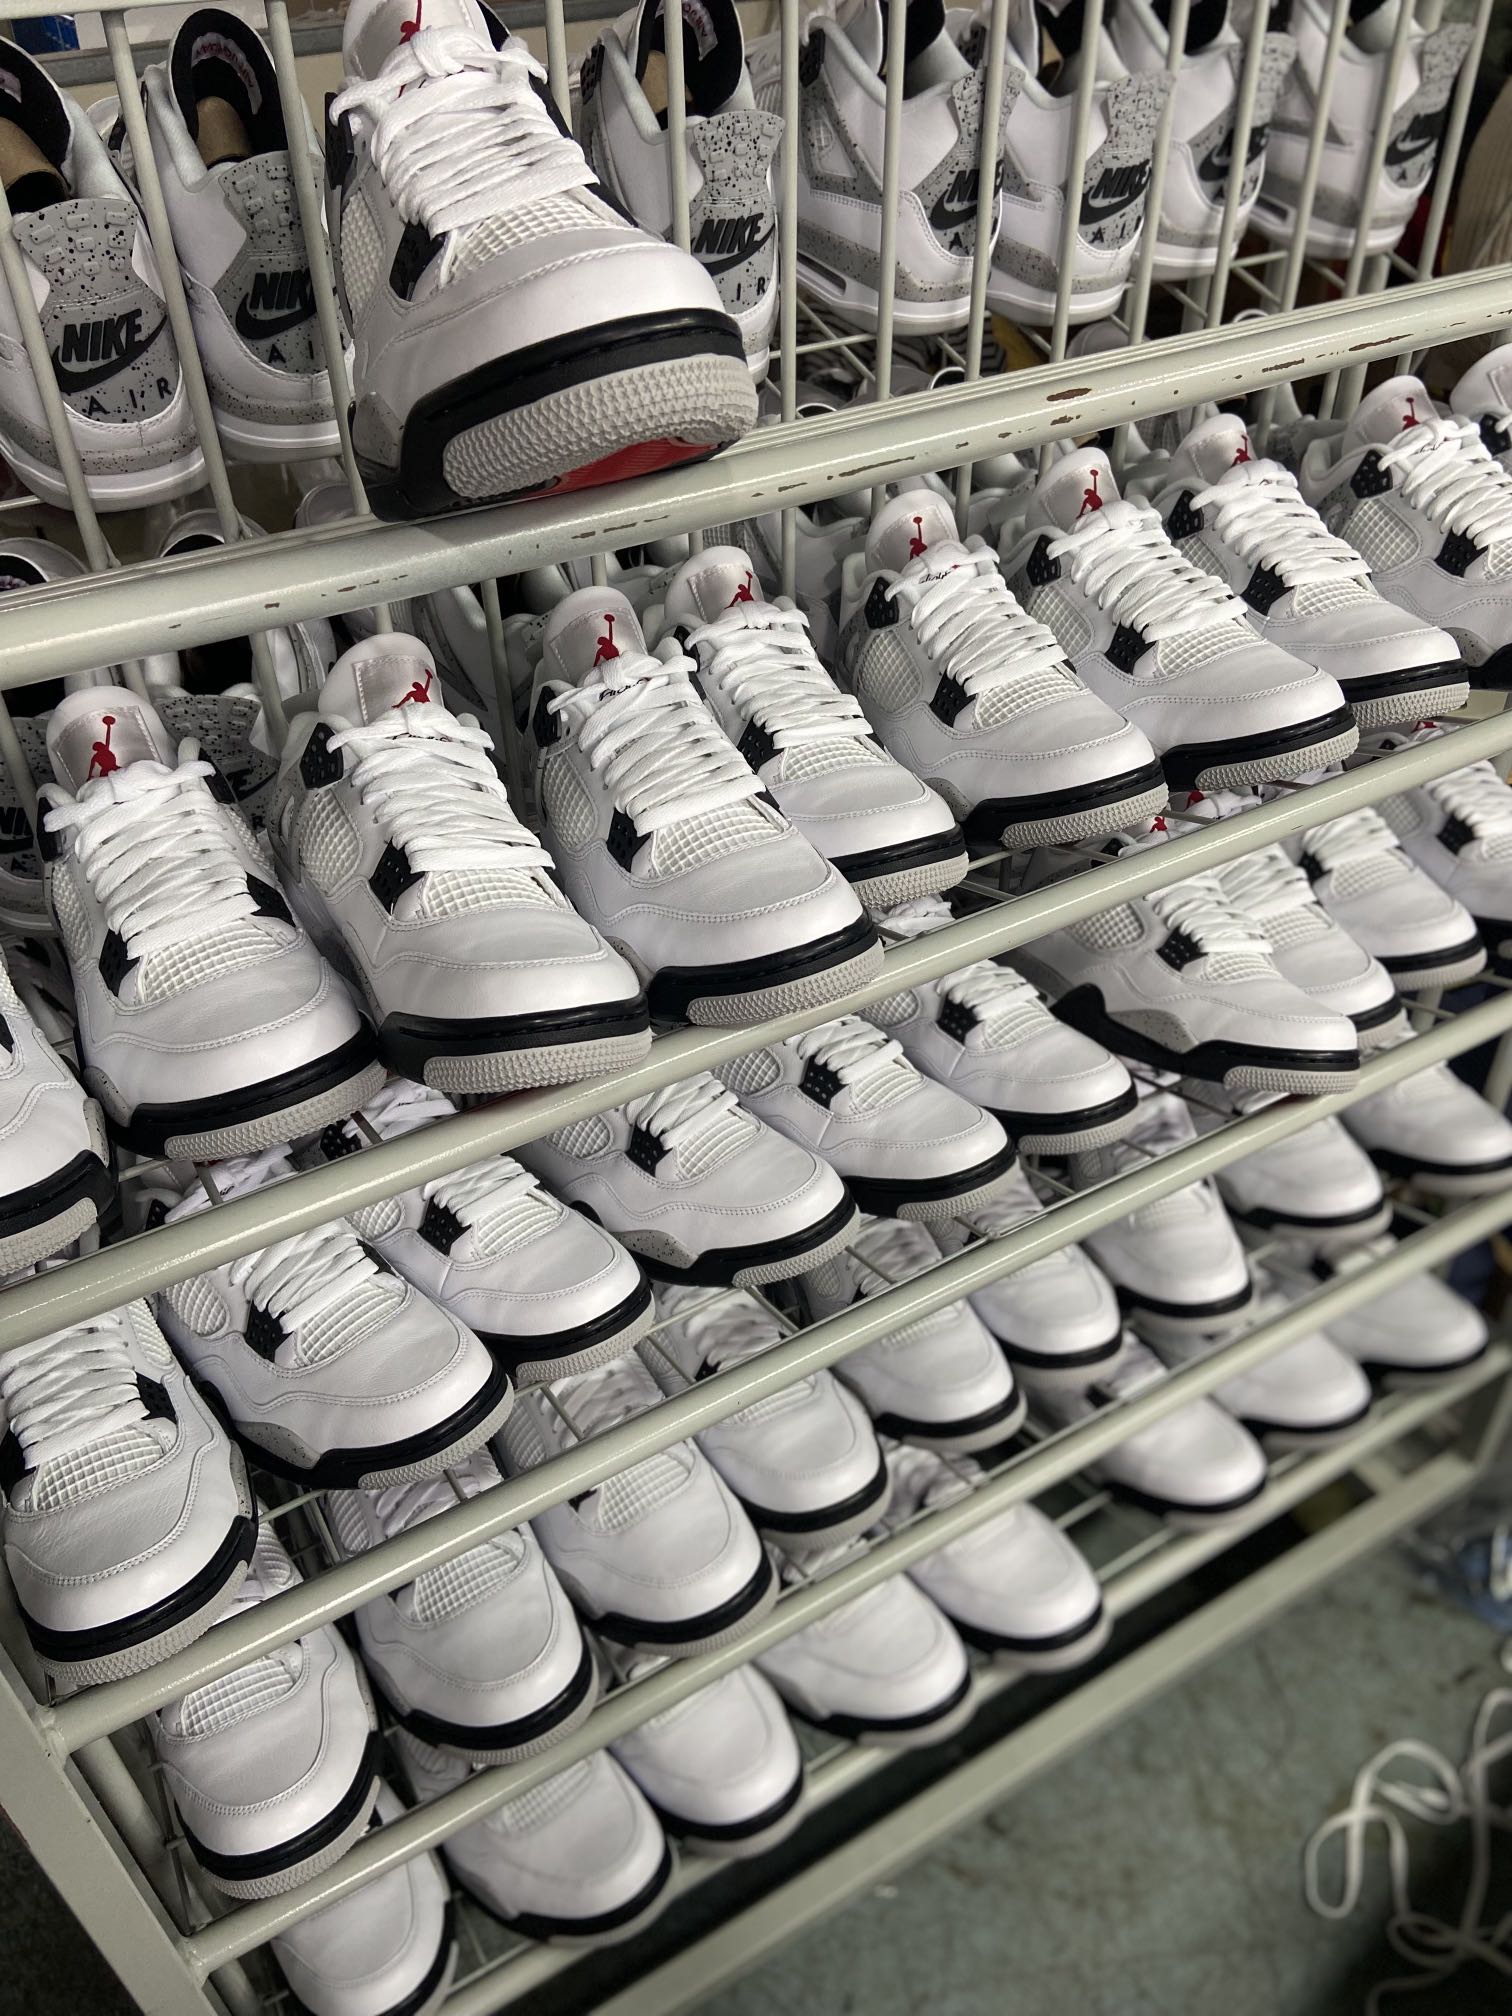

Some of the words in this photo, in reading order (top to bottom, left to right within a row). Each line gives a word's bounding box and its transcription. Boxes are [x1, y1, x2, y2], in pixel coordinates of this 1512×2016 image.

[694, 212, 764, 255] NIKE
[249, 266, 318, 310] NIK
[736, 276, 766, 301] IR
[61, 308, 142, 363] NIKE
[88, 376, 172, 416] AIR
